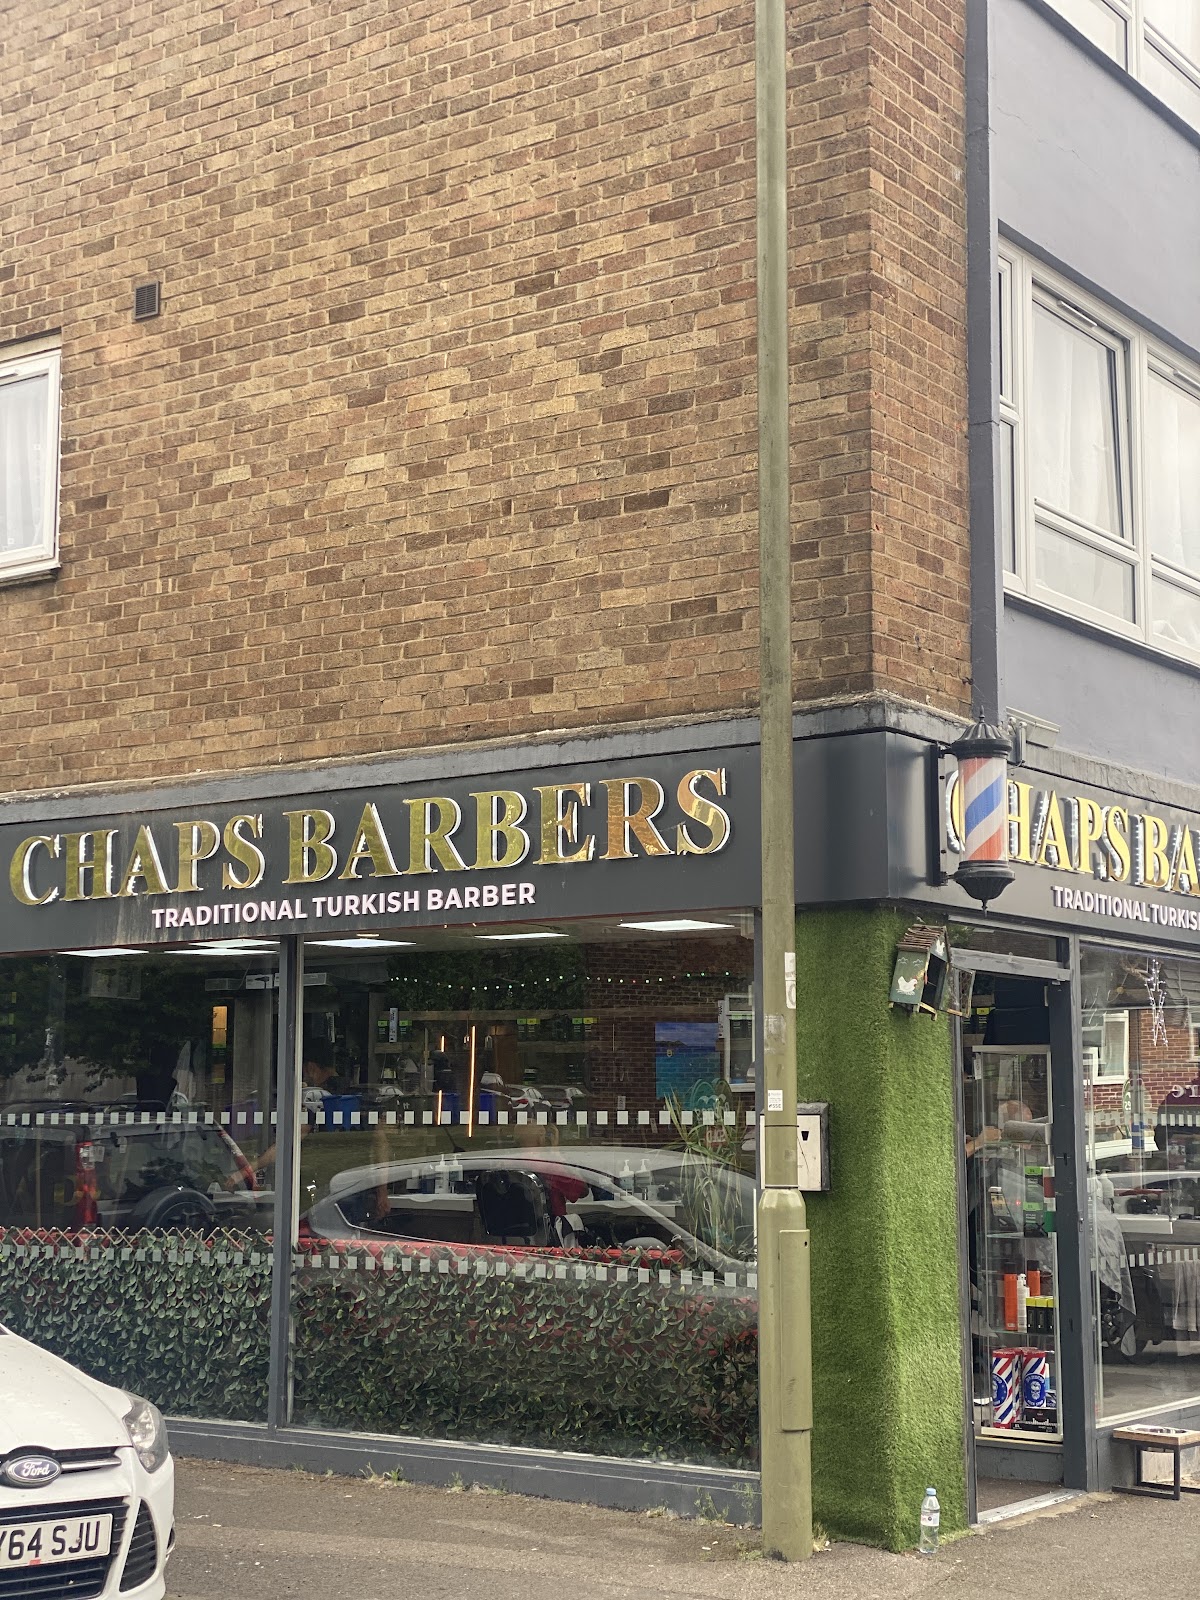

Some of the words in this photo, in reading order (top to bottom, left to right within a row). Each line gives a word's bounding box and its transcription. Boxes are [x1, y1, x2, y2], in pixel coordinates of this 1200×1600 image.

[10, 814, 266, 905] CHAPS
[282, 767, 731, 884] BARBERS
[946, 769, 1130, 883] HAPS
[151, 898, 308, 928] TRADITIONAL
[312, 890, 421, 918] TURKISH
[426, 882, 537, 911] BARBER
[1053, 885, 1150, 922] TRADITIONAL
[22, 1461, 51, 1477] Ford
[51, 1520, 101, 1556] SJU
